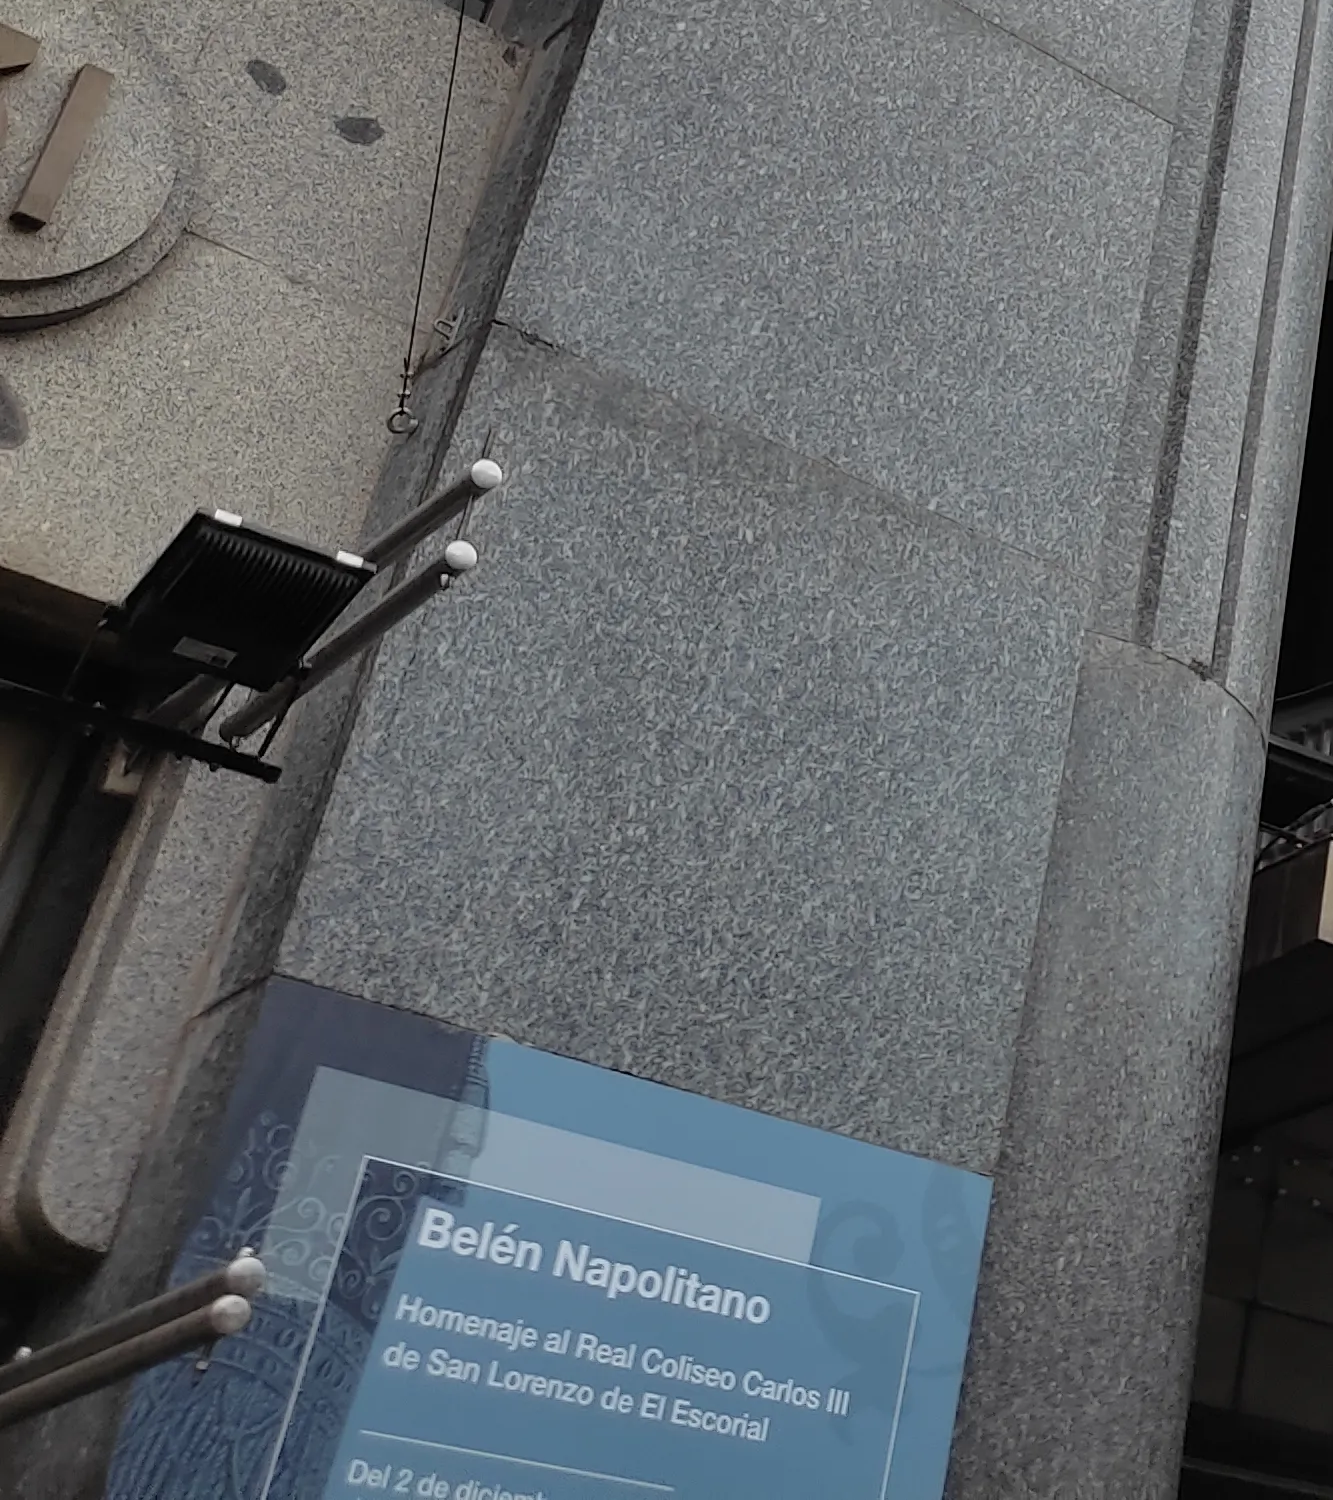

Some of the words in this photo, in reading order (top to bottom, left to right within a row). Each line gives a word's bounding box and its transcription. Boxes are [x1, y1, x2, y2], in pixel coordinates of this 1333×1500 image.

[417, 1207, 543, 1272] Belén
[552, 1239, 771, 1324] Napolitano
[383, 1342, 421, 1371] de
[426, 1348, 481, 1384] San
[488, 1360, 595, 1406] Lorenzo
[600, 1385, 634, 1414] de
[639, 1392, 667, 1421] El
[670, 1399, 770, 1442] Escorial
[395, 1294, 538, 1351] Homenaje
[543, 1329, 571, 1355] al
[575, 1333, 637, 1370] Real
[641, 1348, 736, 1391] Coliseo
[742, 1370, 821, 1411] Carlos
[825, 1388, 851, 1416] III
[347, 1459, 392, 1489] Del
[394, 1468, 414, 1493] 2
[417, 1473, 450, 1500] de
